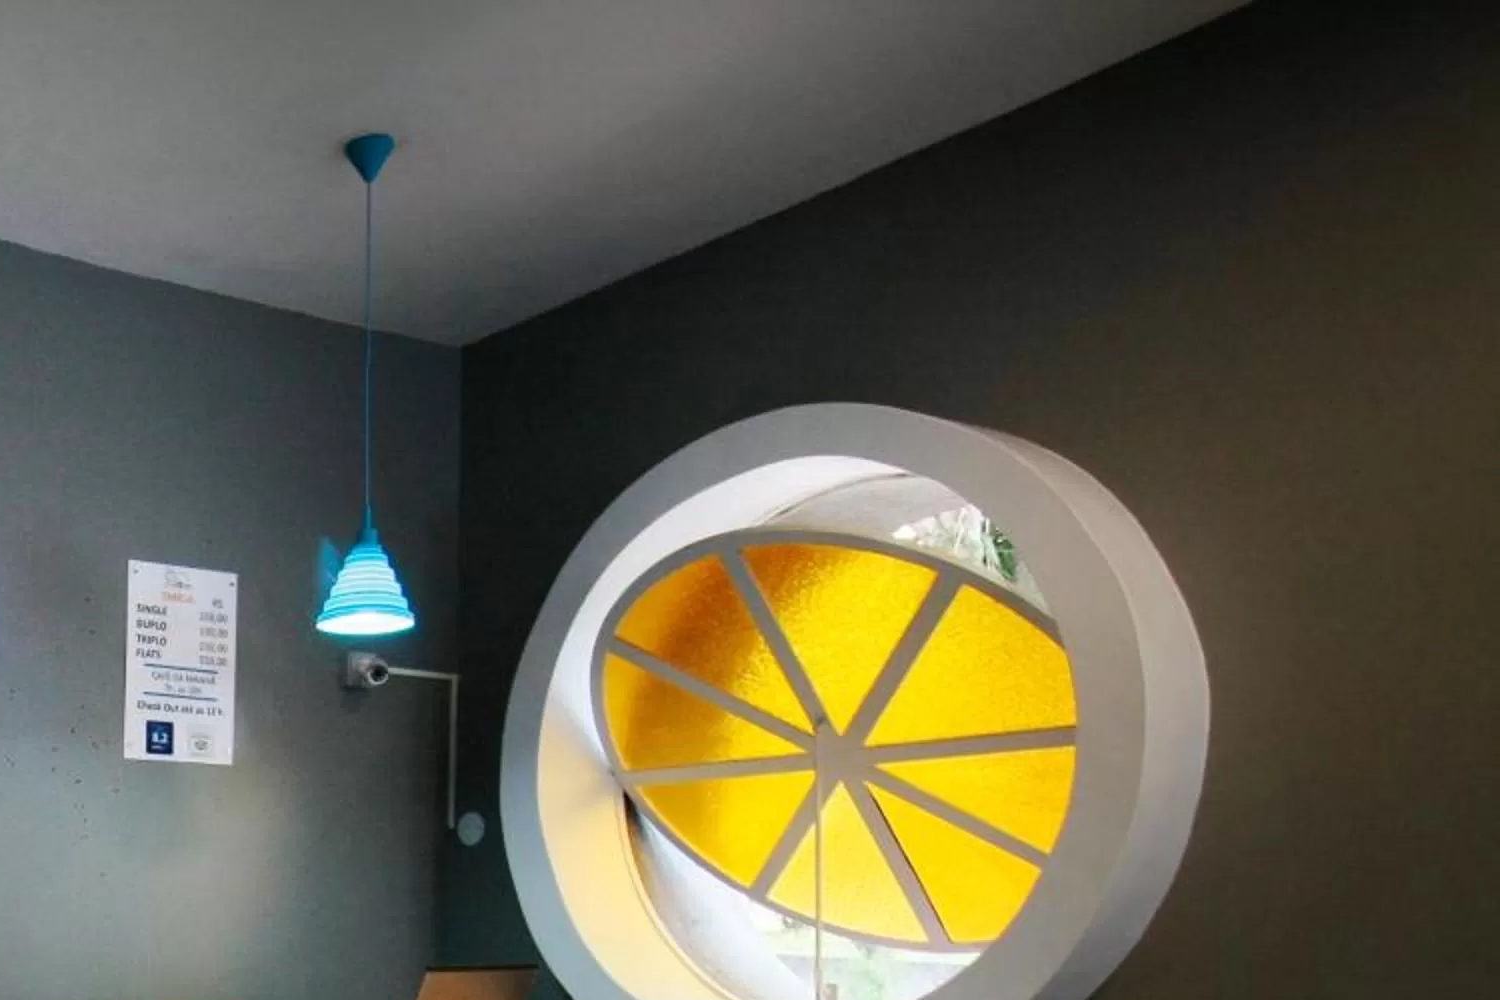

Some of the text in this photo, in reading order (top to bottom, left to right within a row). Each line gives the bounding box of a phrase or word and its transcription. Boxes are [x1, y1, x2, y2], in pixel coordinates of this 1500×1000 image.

[136, 603, 167, 616] SINGLE
[135, 619, 167, 632] DUPLO
[135, 633, 167, 647] TRIPLO
[135, 647, 162, 659] FLATS
